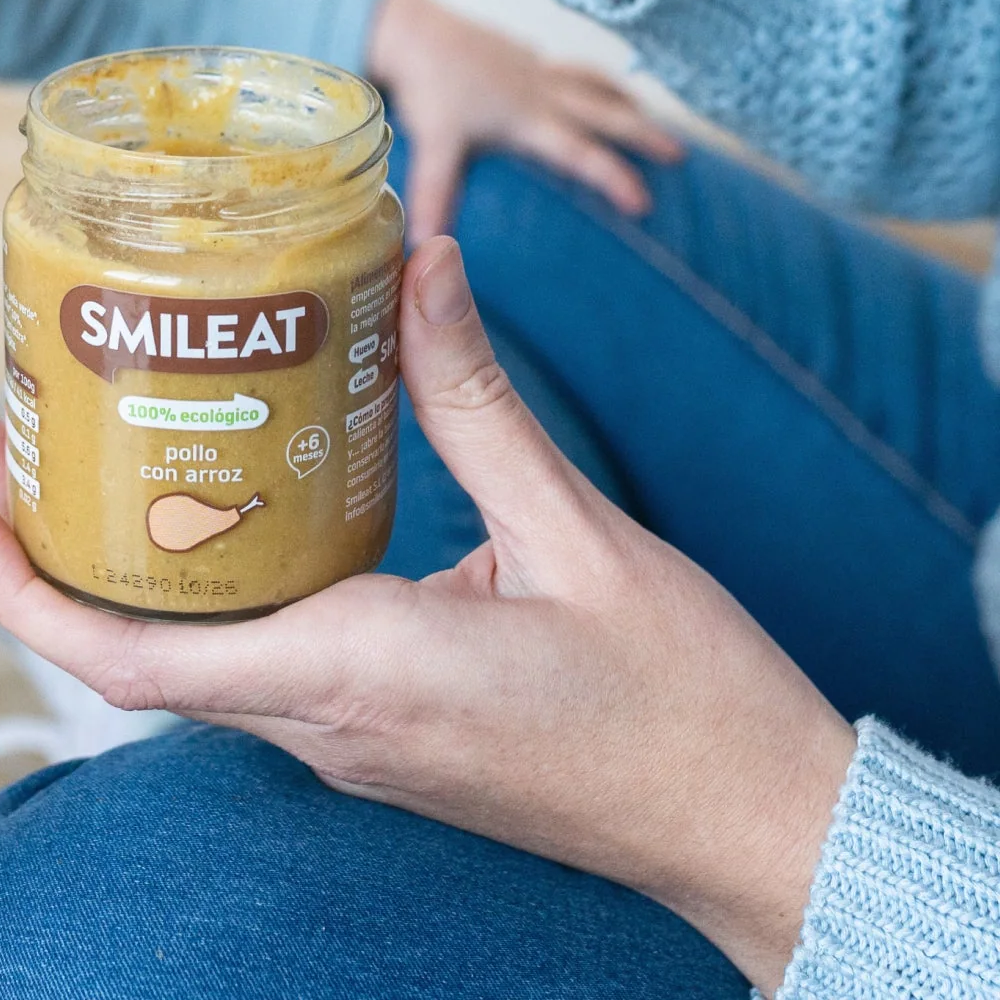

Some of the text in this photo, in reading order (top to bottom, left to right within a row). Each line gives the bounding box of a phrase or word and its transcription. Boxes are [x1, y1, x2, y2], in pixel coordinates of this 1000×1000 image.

[80, 300, 306, 359] SMILEAT
[350, 323, 358, 334] la
[360, 312, 380, 329] mejor
[354, 340, 376, 358] Huevo
[380, 330, 397, 362] SIN
[354, 371, 375, 389] Leche
[127, 403, 260, 426] 100% ecológico
[347, 408, 374, 431] ¿Cómo
[297, 433, 320, 452] +6
[165, 443, 218, 464] pollo
[293, 449, 324, 464] meses
[140, 465, 243, 483] con arroz
